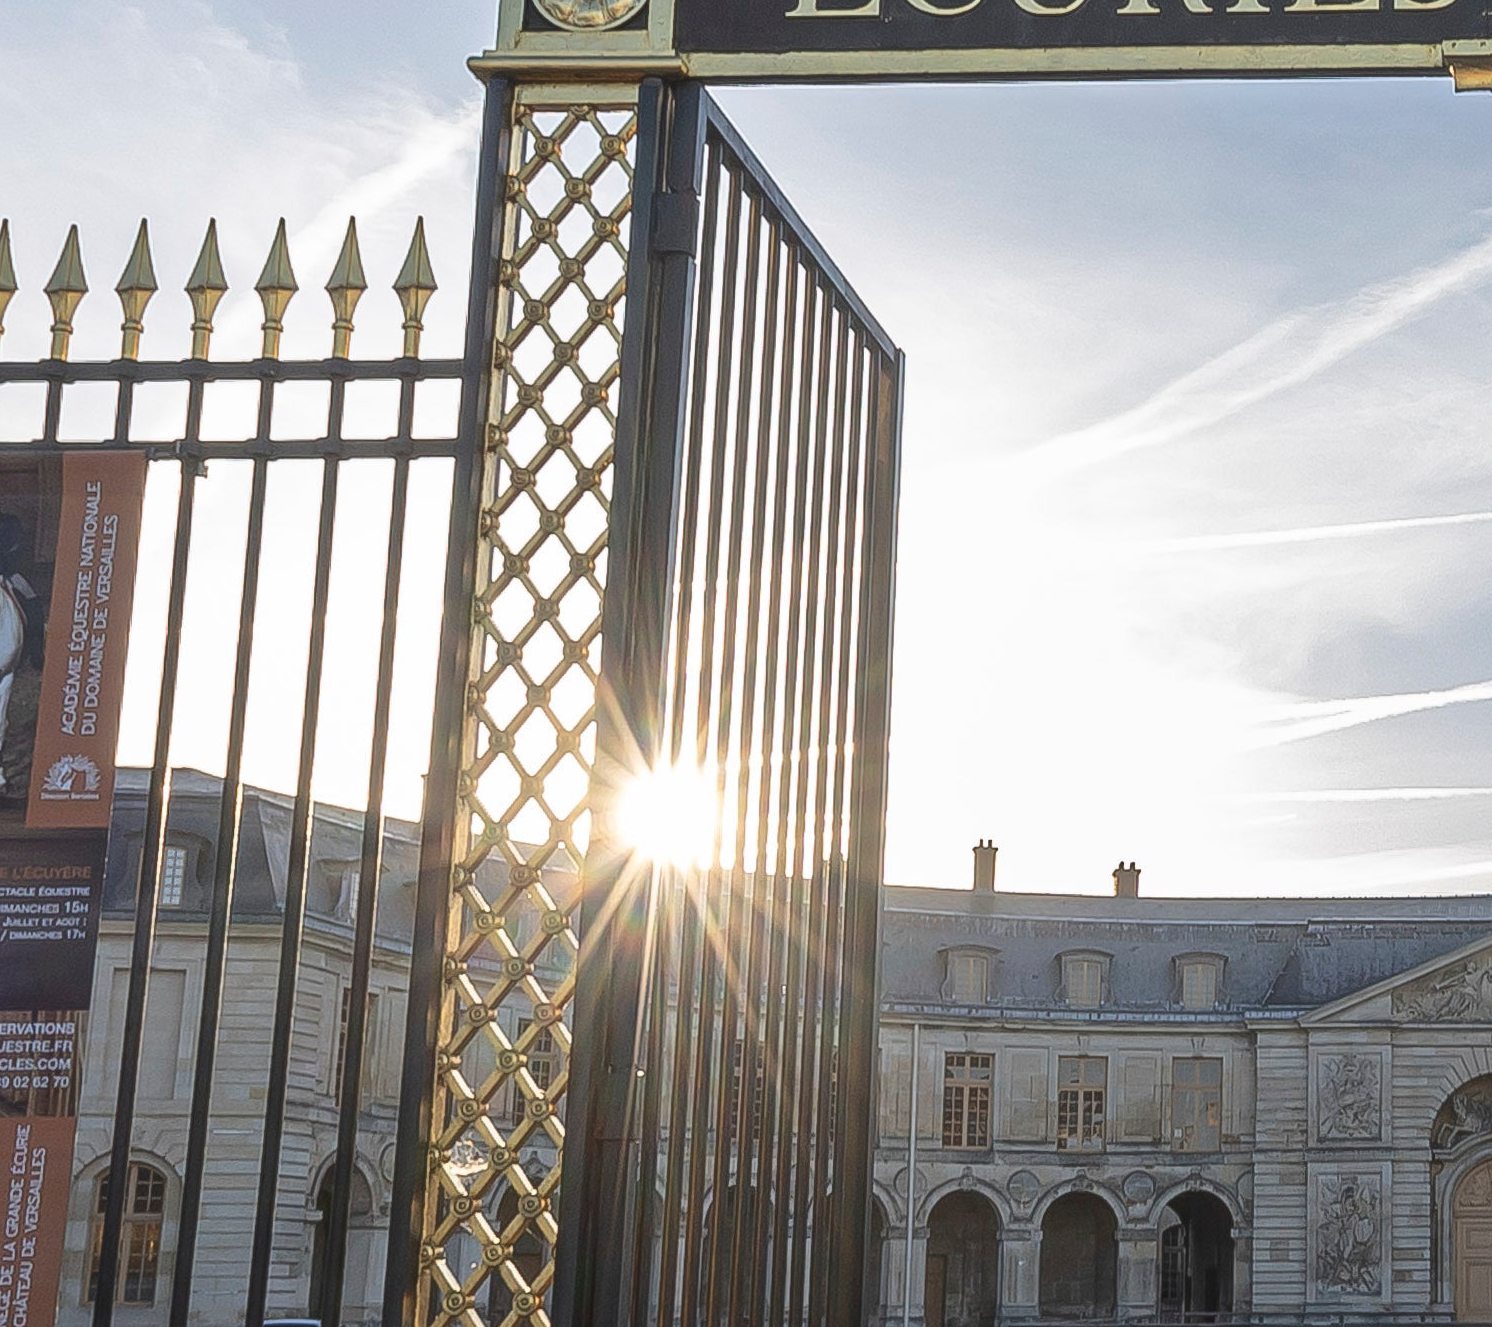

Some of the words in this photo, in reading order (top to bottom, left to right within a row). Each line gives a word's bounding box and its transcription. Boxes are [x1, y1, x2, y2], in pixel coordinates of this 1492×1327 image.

[80, 481, 101, 566] NATIONALE
[96, 515, 118, 604] VERSAILLES
[67, 570, 92, 651] ÉQUESTRE
[93, 608, 108, 629] DE
[61, 655, 83, 735] ACADÉMIE
[84, 634, 106, 707] DOMAINE
[81, 712, 97, 735] DU
[10, 1124, 31, 1175] ÉCURIE
[6, 1178, 24, 1238] GRANDE
[25, 1147, 46, 1234] VERSAILLES
[0, 1265, 14, 1286] DE
[2, 1241, 17, 1262] LA
[21, 1236, 36, 1258] DE
[12, 1261, 33, 1327] CHÂTEAU
